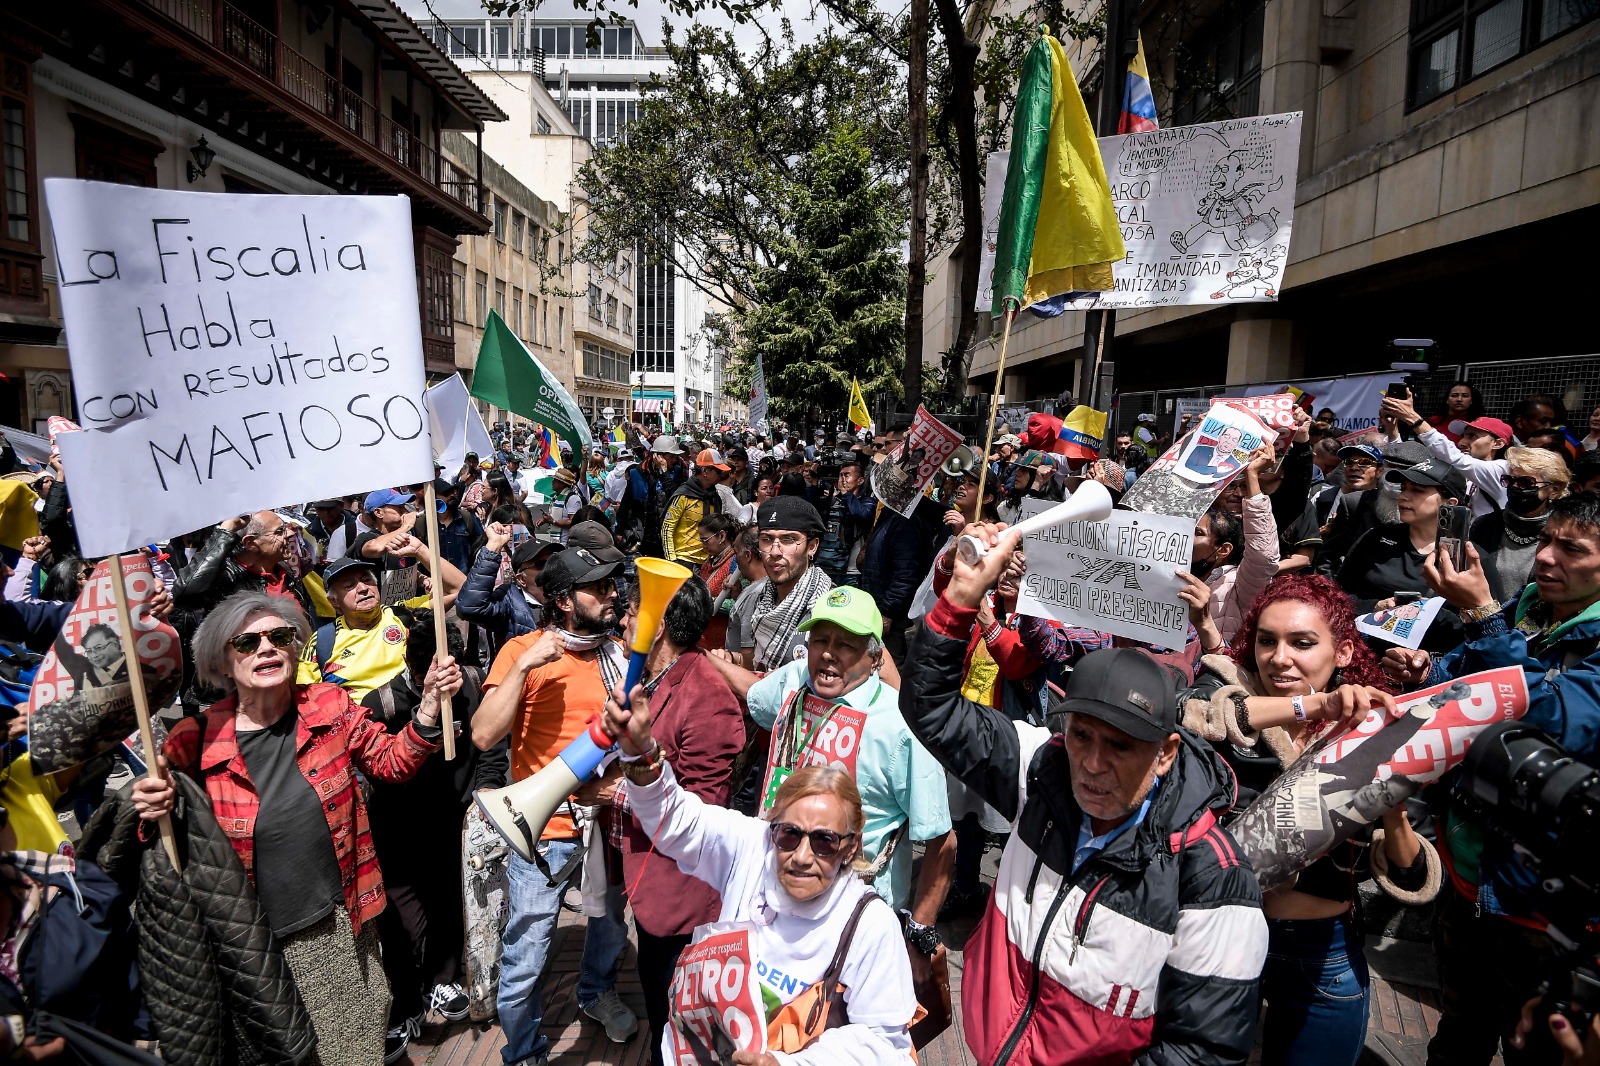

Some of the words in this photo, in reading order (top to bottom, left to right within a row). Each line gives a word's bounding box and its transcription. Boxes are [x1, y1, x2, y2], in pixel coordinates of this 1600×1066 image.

[1124, 165, 1133, 173] EL
[1110, 181, 1151, 200] ARCO
[53, 234, 120, 287] La
[152, 214, 367, 284] Fiscalia
[1113, 279, 1187, 292] ANTIZADAS
[1136, 261, 1221, 278] IMPUNIDAD
[137, 292, 276, 357] Habla
[83, 388, 159, 423] CON
[1243, 398, 1294, 410] TRO
[914, 412, 955, 454] PETRO
[1341, 418, 1376, 430] VAMOS
[908, 432, 944, 466] ETRO
[75, 571, 155, 610] TRO
[1024, 573, 1082, 609] SUBA
[1088, 587, 1185, 631] PRESENTE
[718, 938, 743, 957] respeta!
[673, 956, 745, 1006] PETRO
